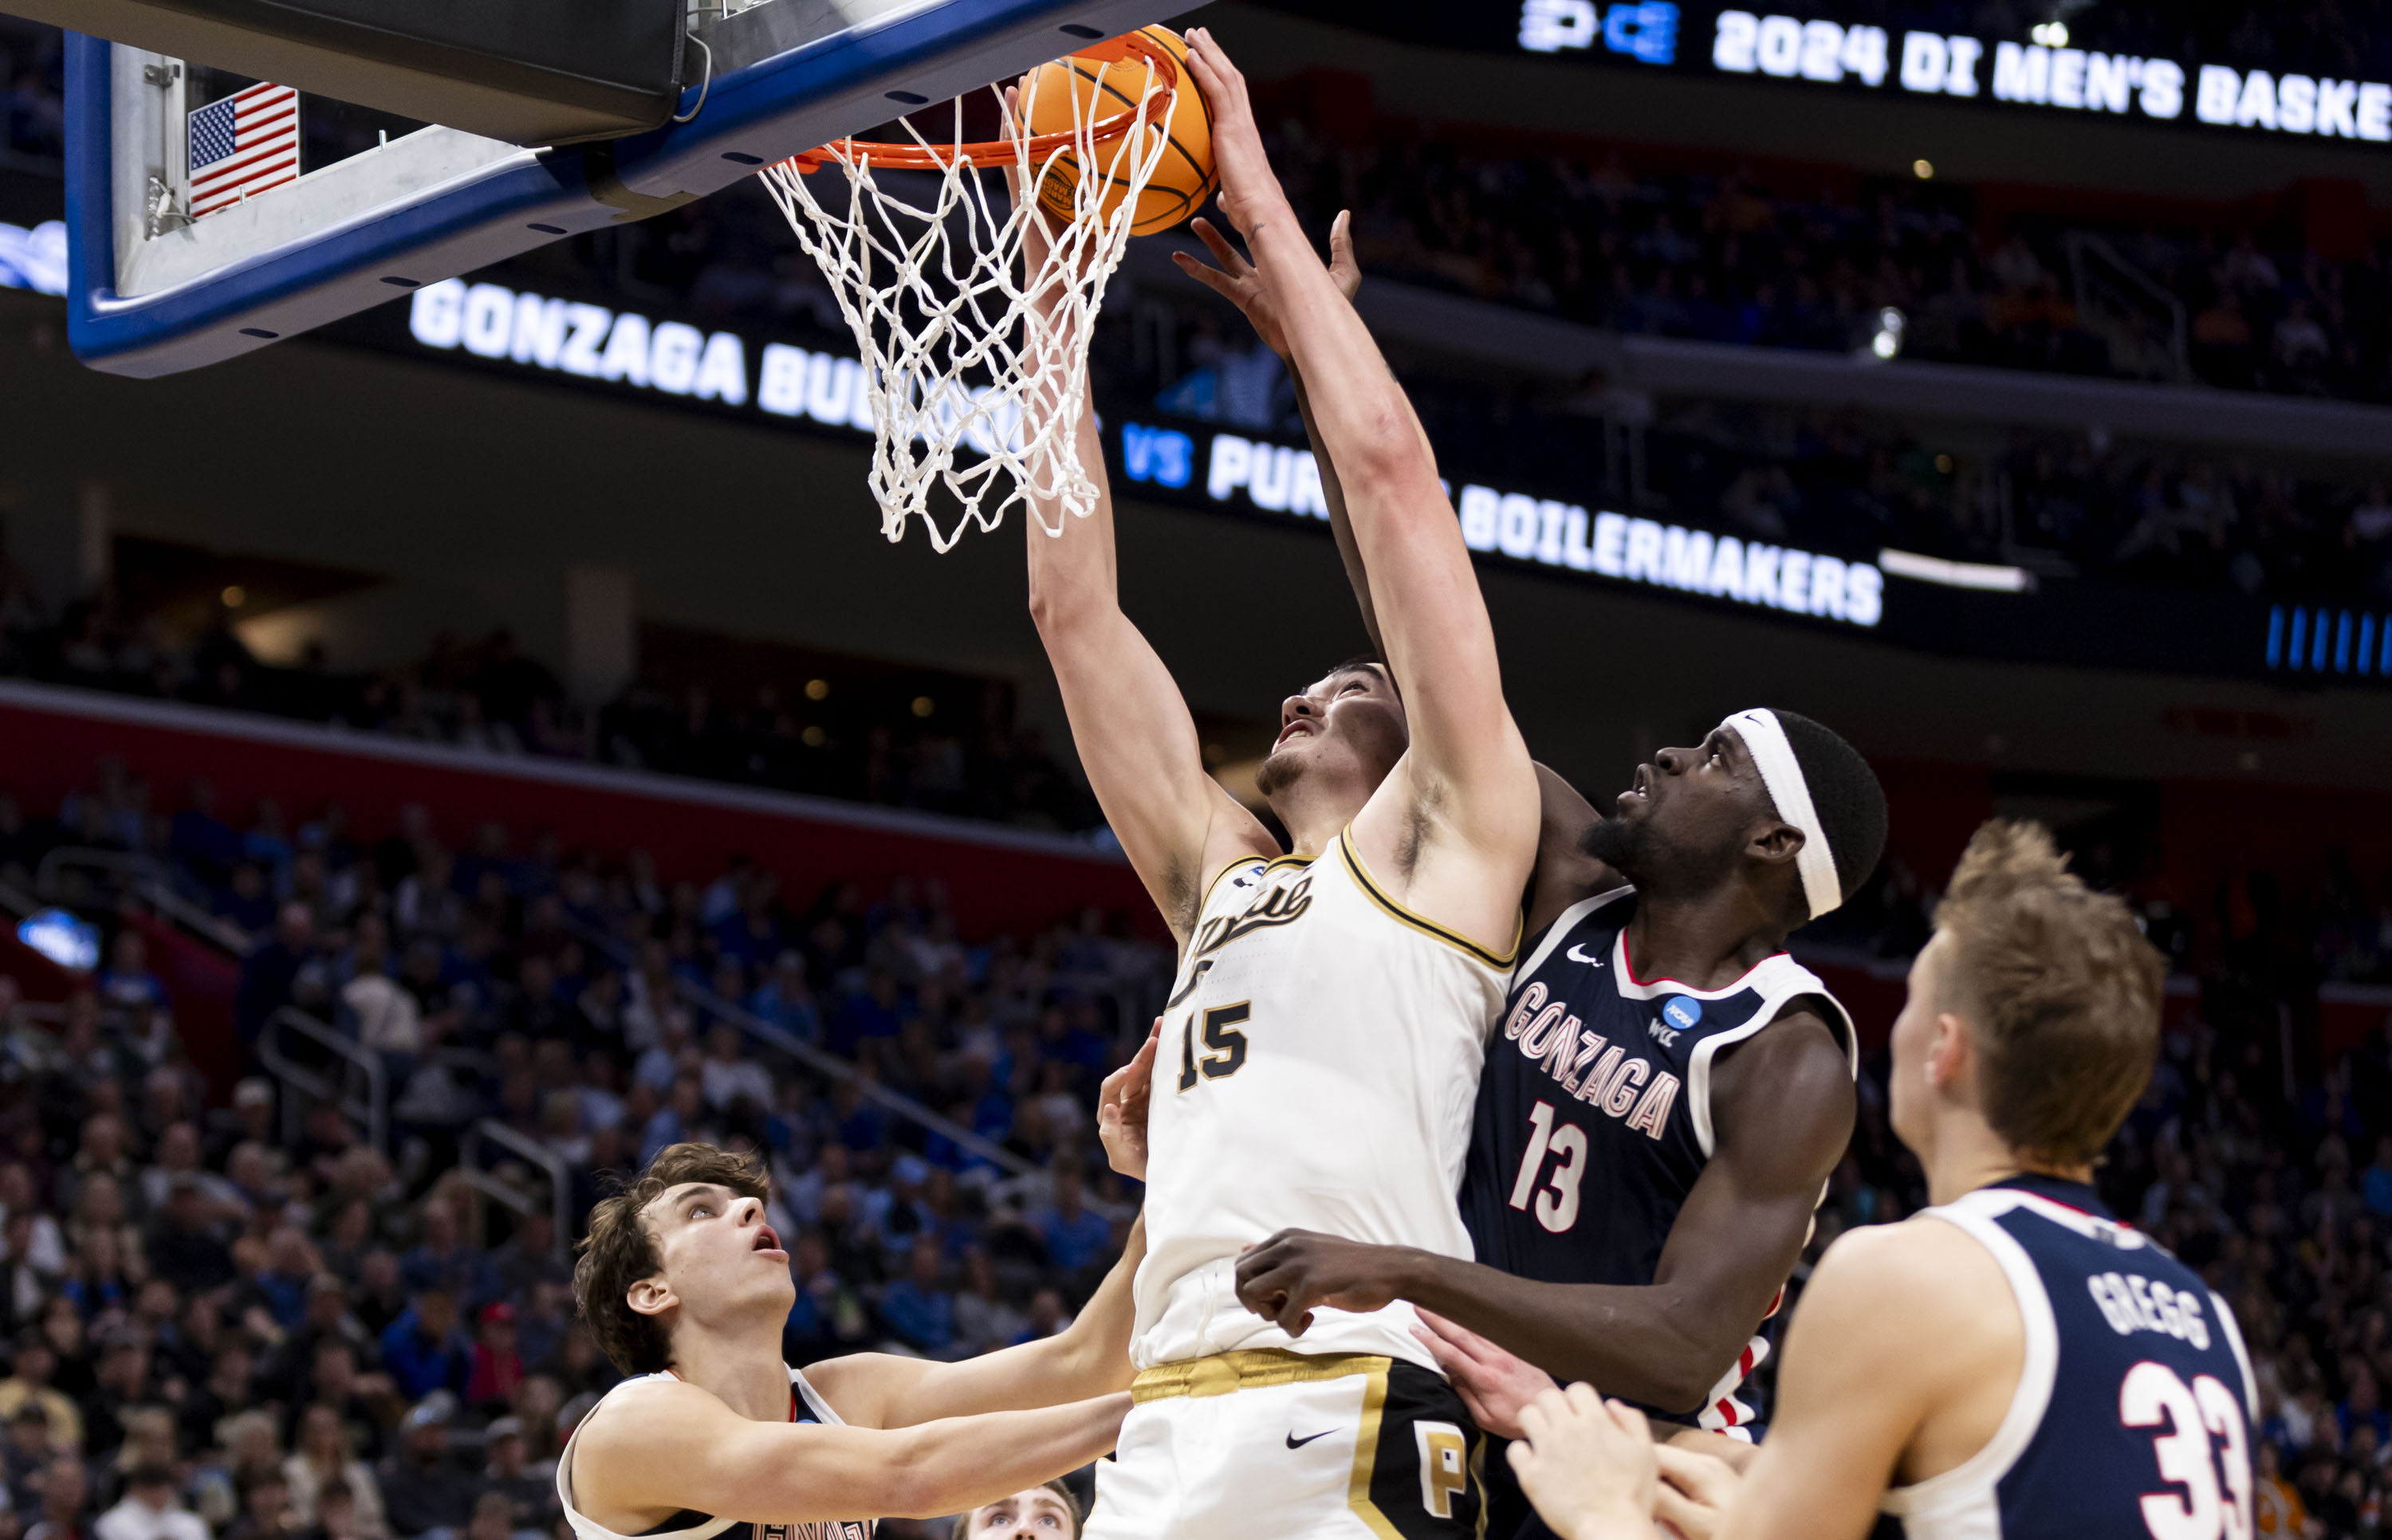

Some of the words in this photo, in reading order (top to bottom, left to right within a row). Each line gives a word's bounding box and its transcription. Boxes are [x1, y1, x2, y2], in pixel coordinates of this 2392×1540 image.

[1713, 10, 1889, 86] 2024
[1993, 42, 2185, 119] MEN'S
[410, 277, 747, 405] GONZAGA
[1122, 422, 1194, 489] VS
[1461, 485, 1883, 626] BOILERMAKERS
[1177, 1000, 1251, 1094] 15
[1505, 981, 1680, 1140] GONZAGA
[1509, 1099, 1587, 1233] 13
[2087, 1271, 2212, 1350] GREGG
[1414, 1420, 1466, 1518] P
[2119, 1358, 2256, 1540] 33
